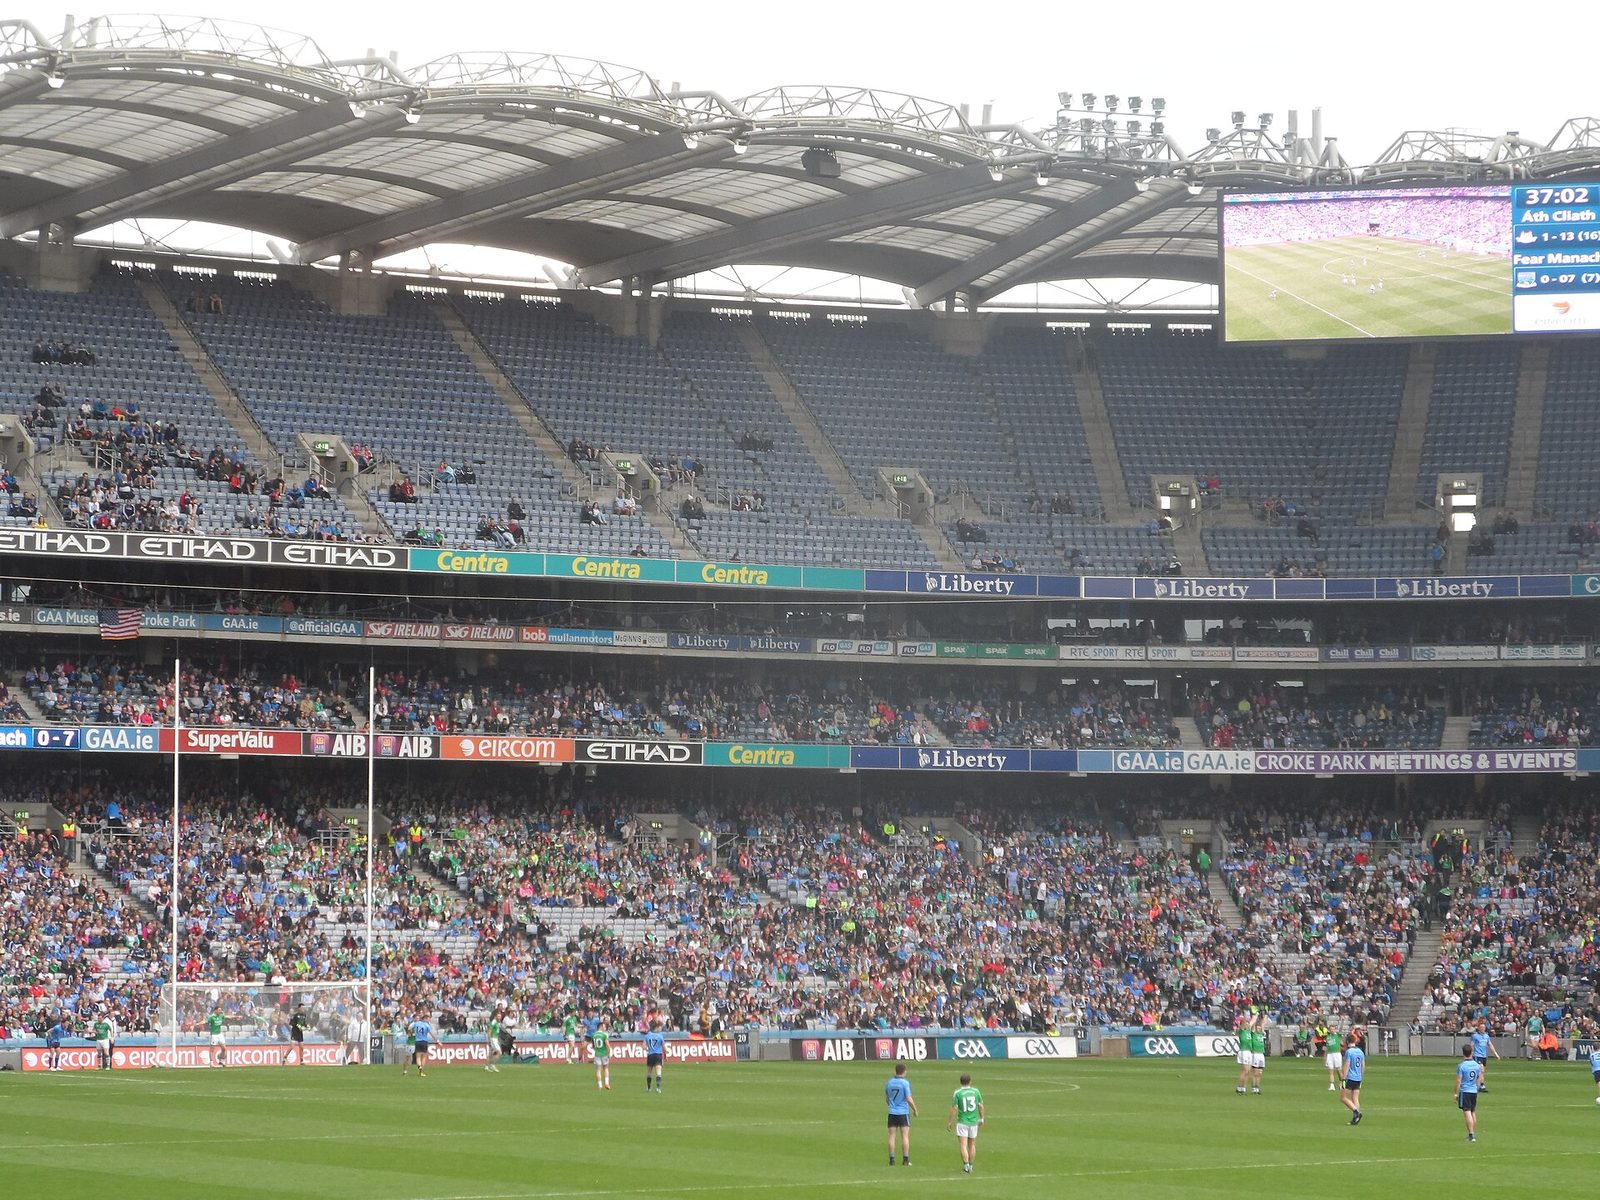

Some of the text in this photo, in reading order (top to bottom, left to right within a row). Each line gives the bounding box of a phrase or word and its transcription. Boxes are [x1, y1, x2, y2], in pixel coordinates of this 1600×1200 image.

[1526, 188, 1589, 204] 37:02
[1552, 209, 1596, 221] Cliath
[1559, 231, 1575, 241] 13
[1514, 254, 1546, 265] Fear
[1559, 274, 1576, 284] 07
[0, 531, 110, 553] ETIHAD
[139, 537, 256, 560] ETIHAD
[283, 544, 396, 567] ETIHAD
[437, 551, 508, 574] Centra
[572, 556, 641, 579] Centra
[702, 563, 768, 585] Centra
[939, 574, 1014, 596] Liberty
[1169, 580, 1250, 599] Liberty
[1411, 579, 1494, 598] Liberty
[37, 610, 63, 623] GAA
[66, 611, 100, 624] Museu
[172, 614, 196, 627] Park
[222, 617, 259, 630] GAA.ie
[289, 620, 356, 634] @officialGAA
[393, 623, 440, 637] IRELAND
[471, 627, 514, 640] IRELAND
[522, 628, 613, 644] bob mullanmotors
[685, 636, 730, 649] Liberty
[757, 637, 800, 651] Liberty
[1093, 648, 1118, 657] SPORT
[1151, 648, 1177, 658] SPORT
[1329, 649, 1349, 657] Chill
[1354, 649, 1374, 657] Chill
[1379, 649, 1399, 657] Chill
[37, 730, 49, 746] 0
[62, 730, 75, 746] 7
[85, 728, 153, 750] GAA.ie
[187, 730, 274, 751] SuperValu
[331, 734, 366, 756] AIB
[398, 736, 432, 758] AIB
[586, 741, 691, 762] ETIHAD
[728, 745, 795, 765] Centra
[931, 749, 1007, 771] Liberty
[1116, 752, 1182, 771] GAA.ie
[1187, 753, 1251, 771] GAA.ie
[1255, 752, 1576, 770] CROKE PARK MEETINGS & EVENTS
[370, 1038, 380, 1047] 19
[593, 1037, 603, 1048] 10
[649, 1038, 658, 1047] 17
[737, 1034, 747, 1043] 20
[427, 1044, 490, 1064] SuperVal
[665, 1041, 732, 1062] SuperValu
[823, 1039, 855, 1061] AIB
[896, 1038, 928, 1061] AIB
[1355, 1056, 1362, 1068] 8
[1469, 1070, 1477, 1082] 9
[891, 1088, 900, 1101] 7
[962, 1096, 976, 1112] 13
